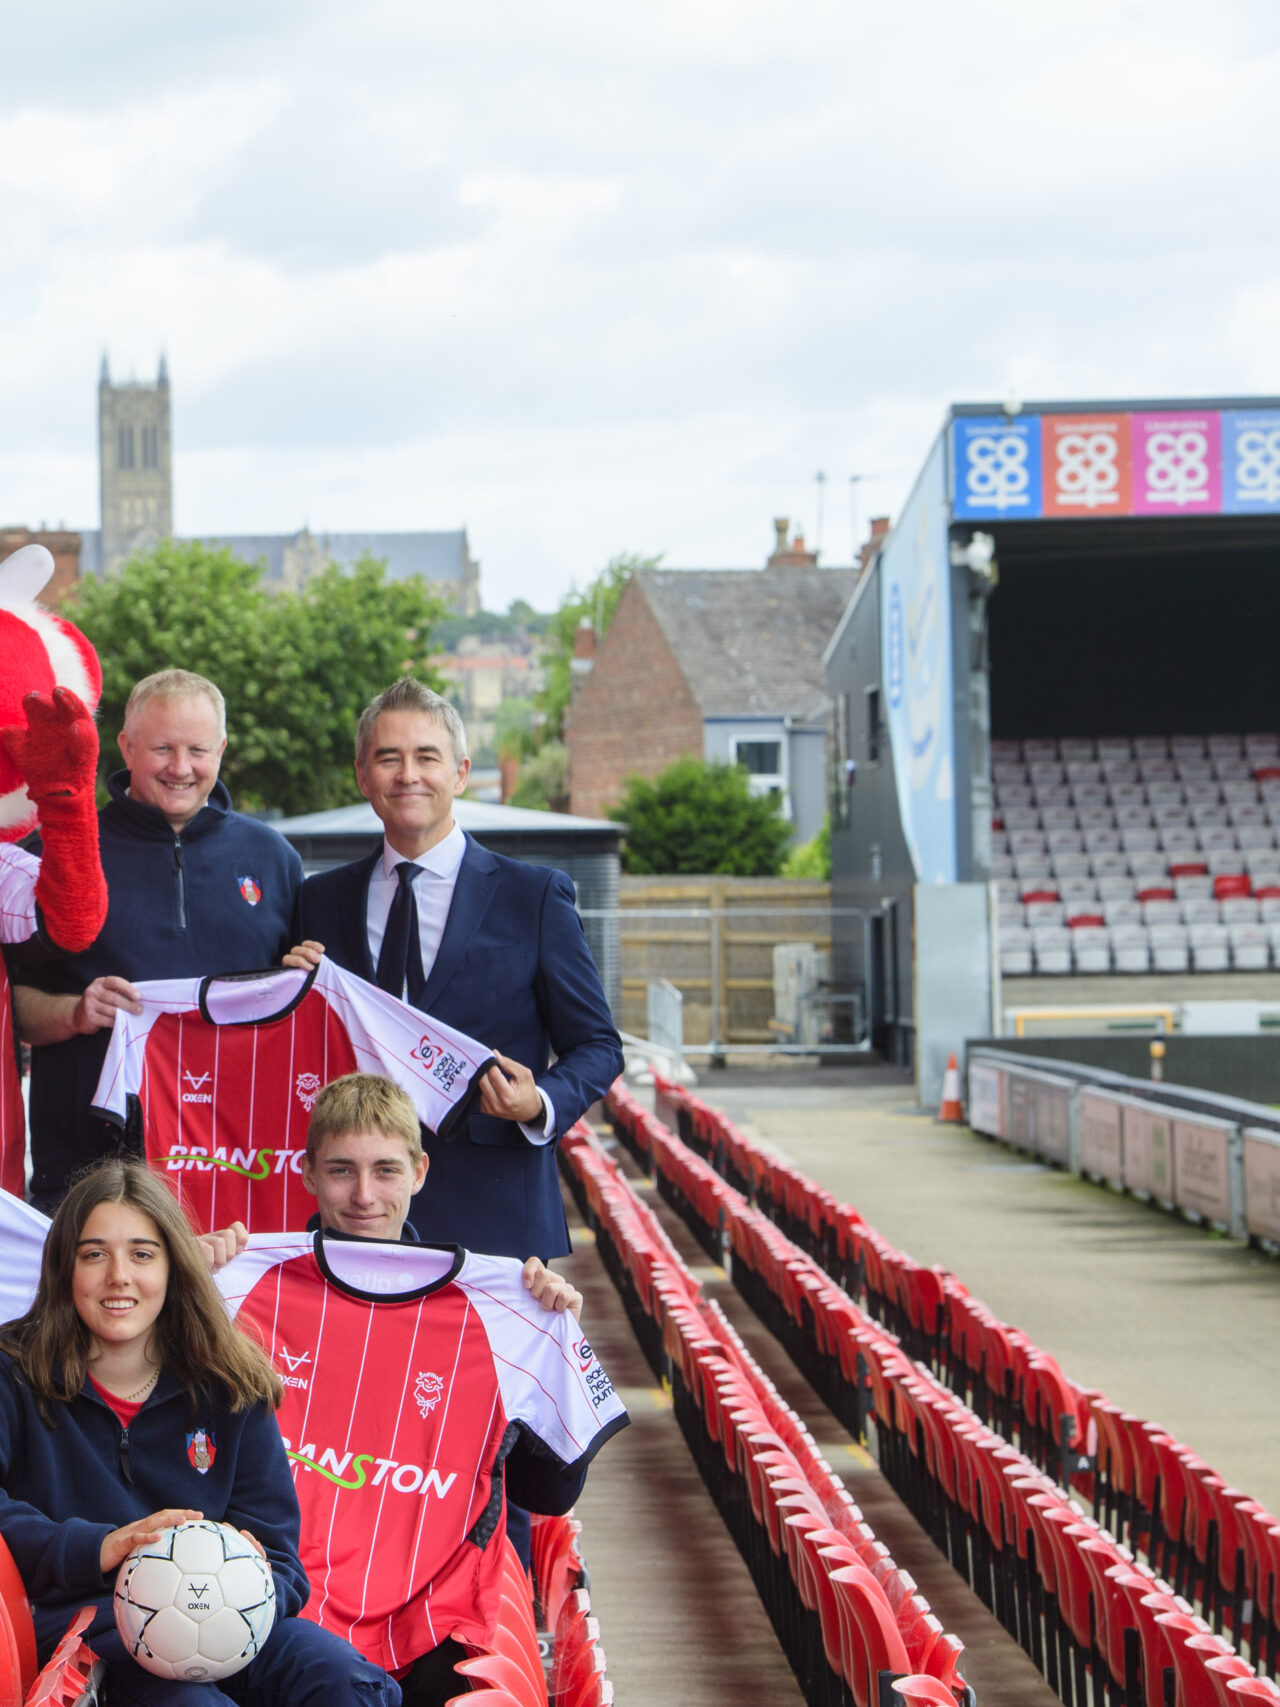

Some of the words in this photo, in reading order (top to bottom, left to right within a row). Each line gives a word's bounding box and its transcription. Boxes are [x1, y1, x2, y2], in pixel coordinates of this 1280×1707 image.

[433, 1052, 455, 1077] easy
[437, 1059, 458, 1083] heat
[442, 1060, 467, 1093] pumps
[182, 1093, 212, 1104] OXEN
[187, 1602, 210, 1610] OXEN
